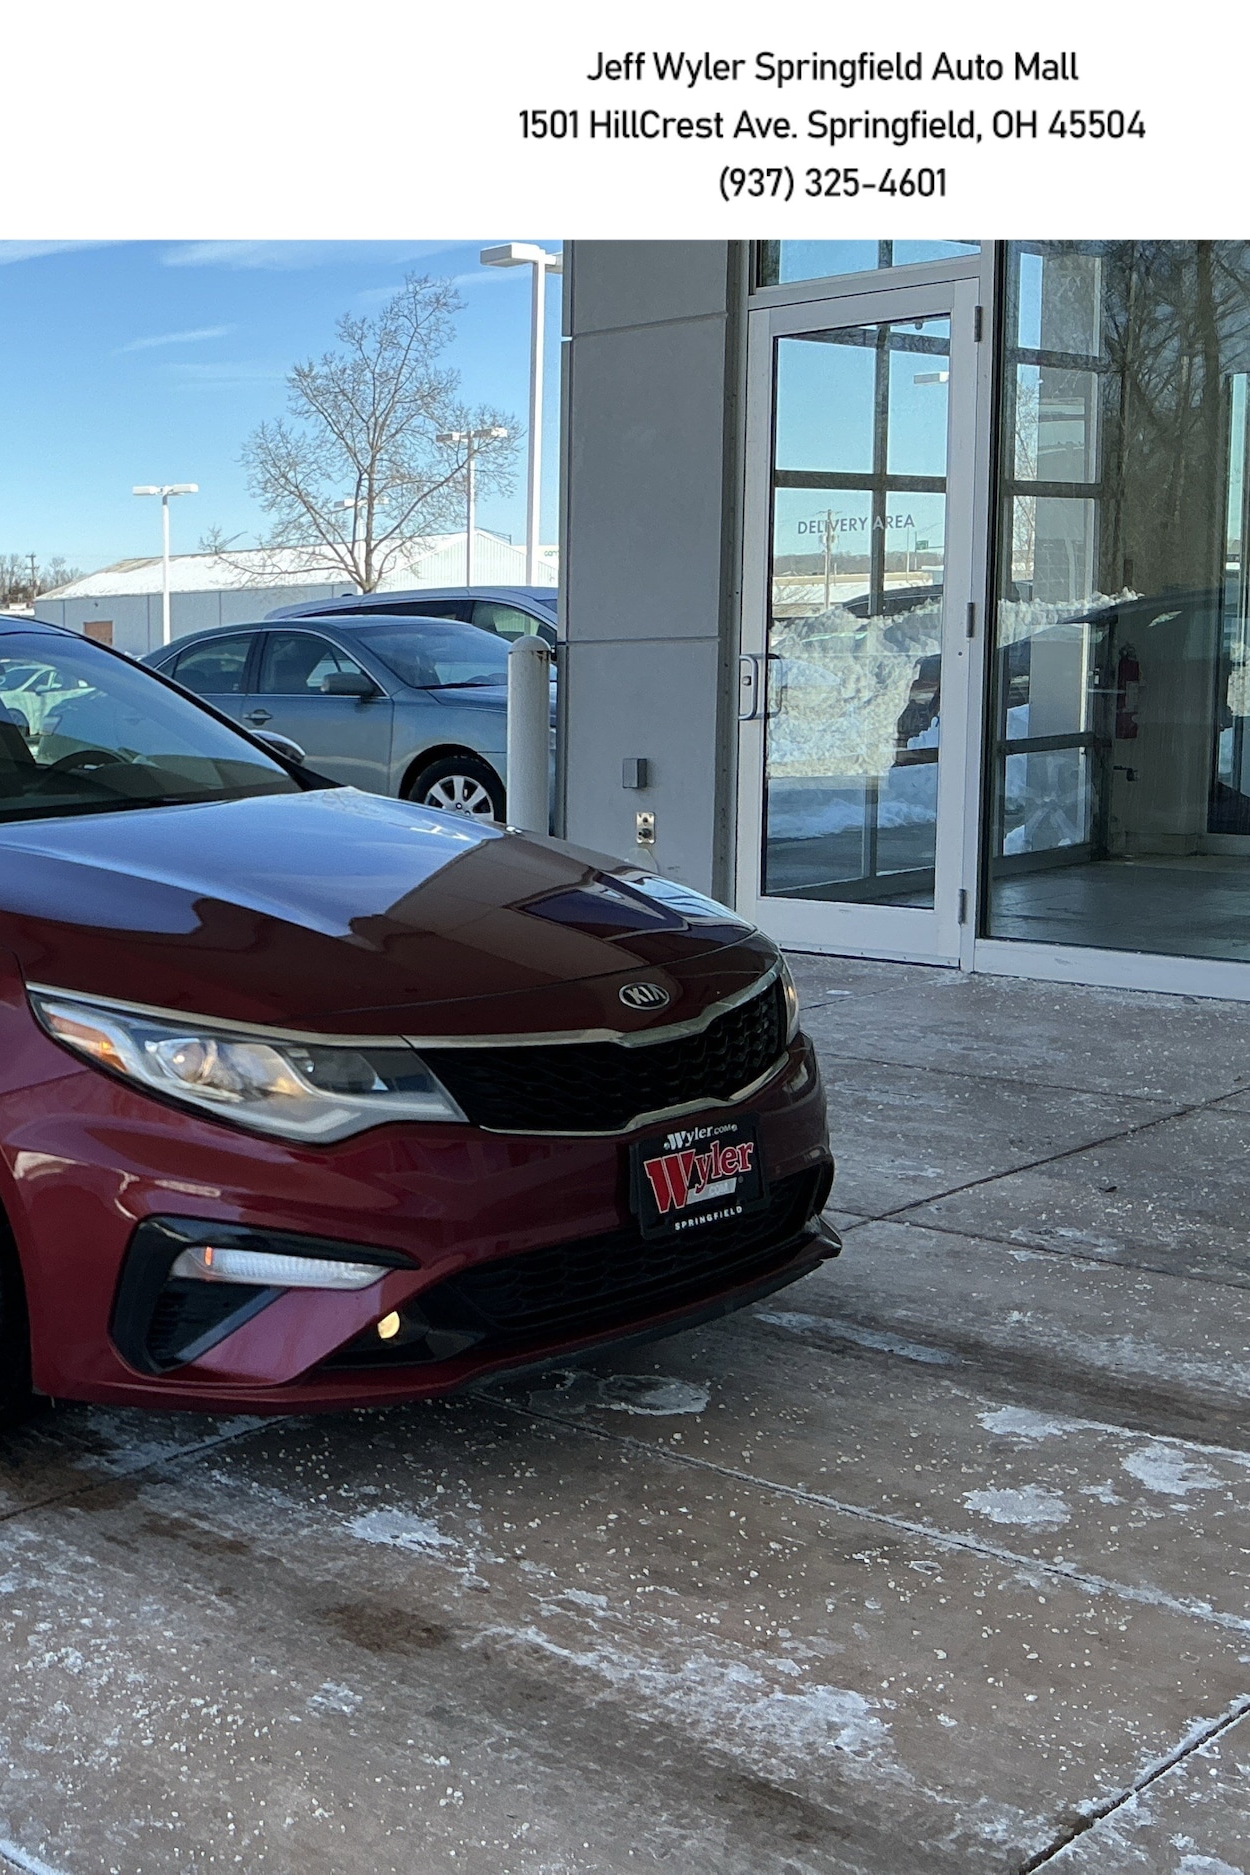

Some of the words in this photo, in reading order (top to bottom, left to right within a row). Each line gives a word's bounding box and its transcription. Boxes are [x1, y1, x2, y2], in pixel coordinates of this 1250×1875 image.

[797, 517, 868, 534] DELIVERY
[872, 514, 916, 530] AREA
[624, 983, 667, 1005] KIA
[644, 1140, 754, 1214] Wyler
[674, 1205, 743, 1231] SPRINGFIELD
